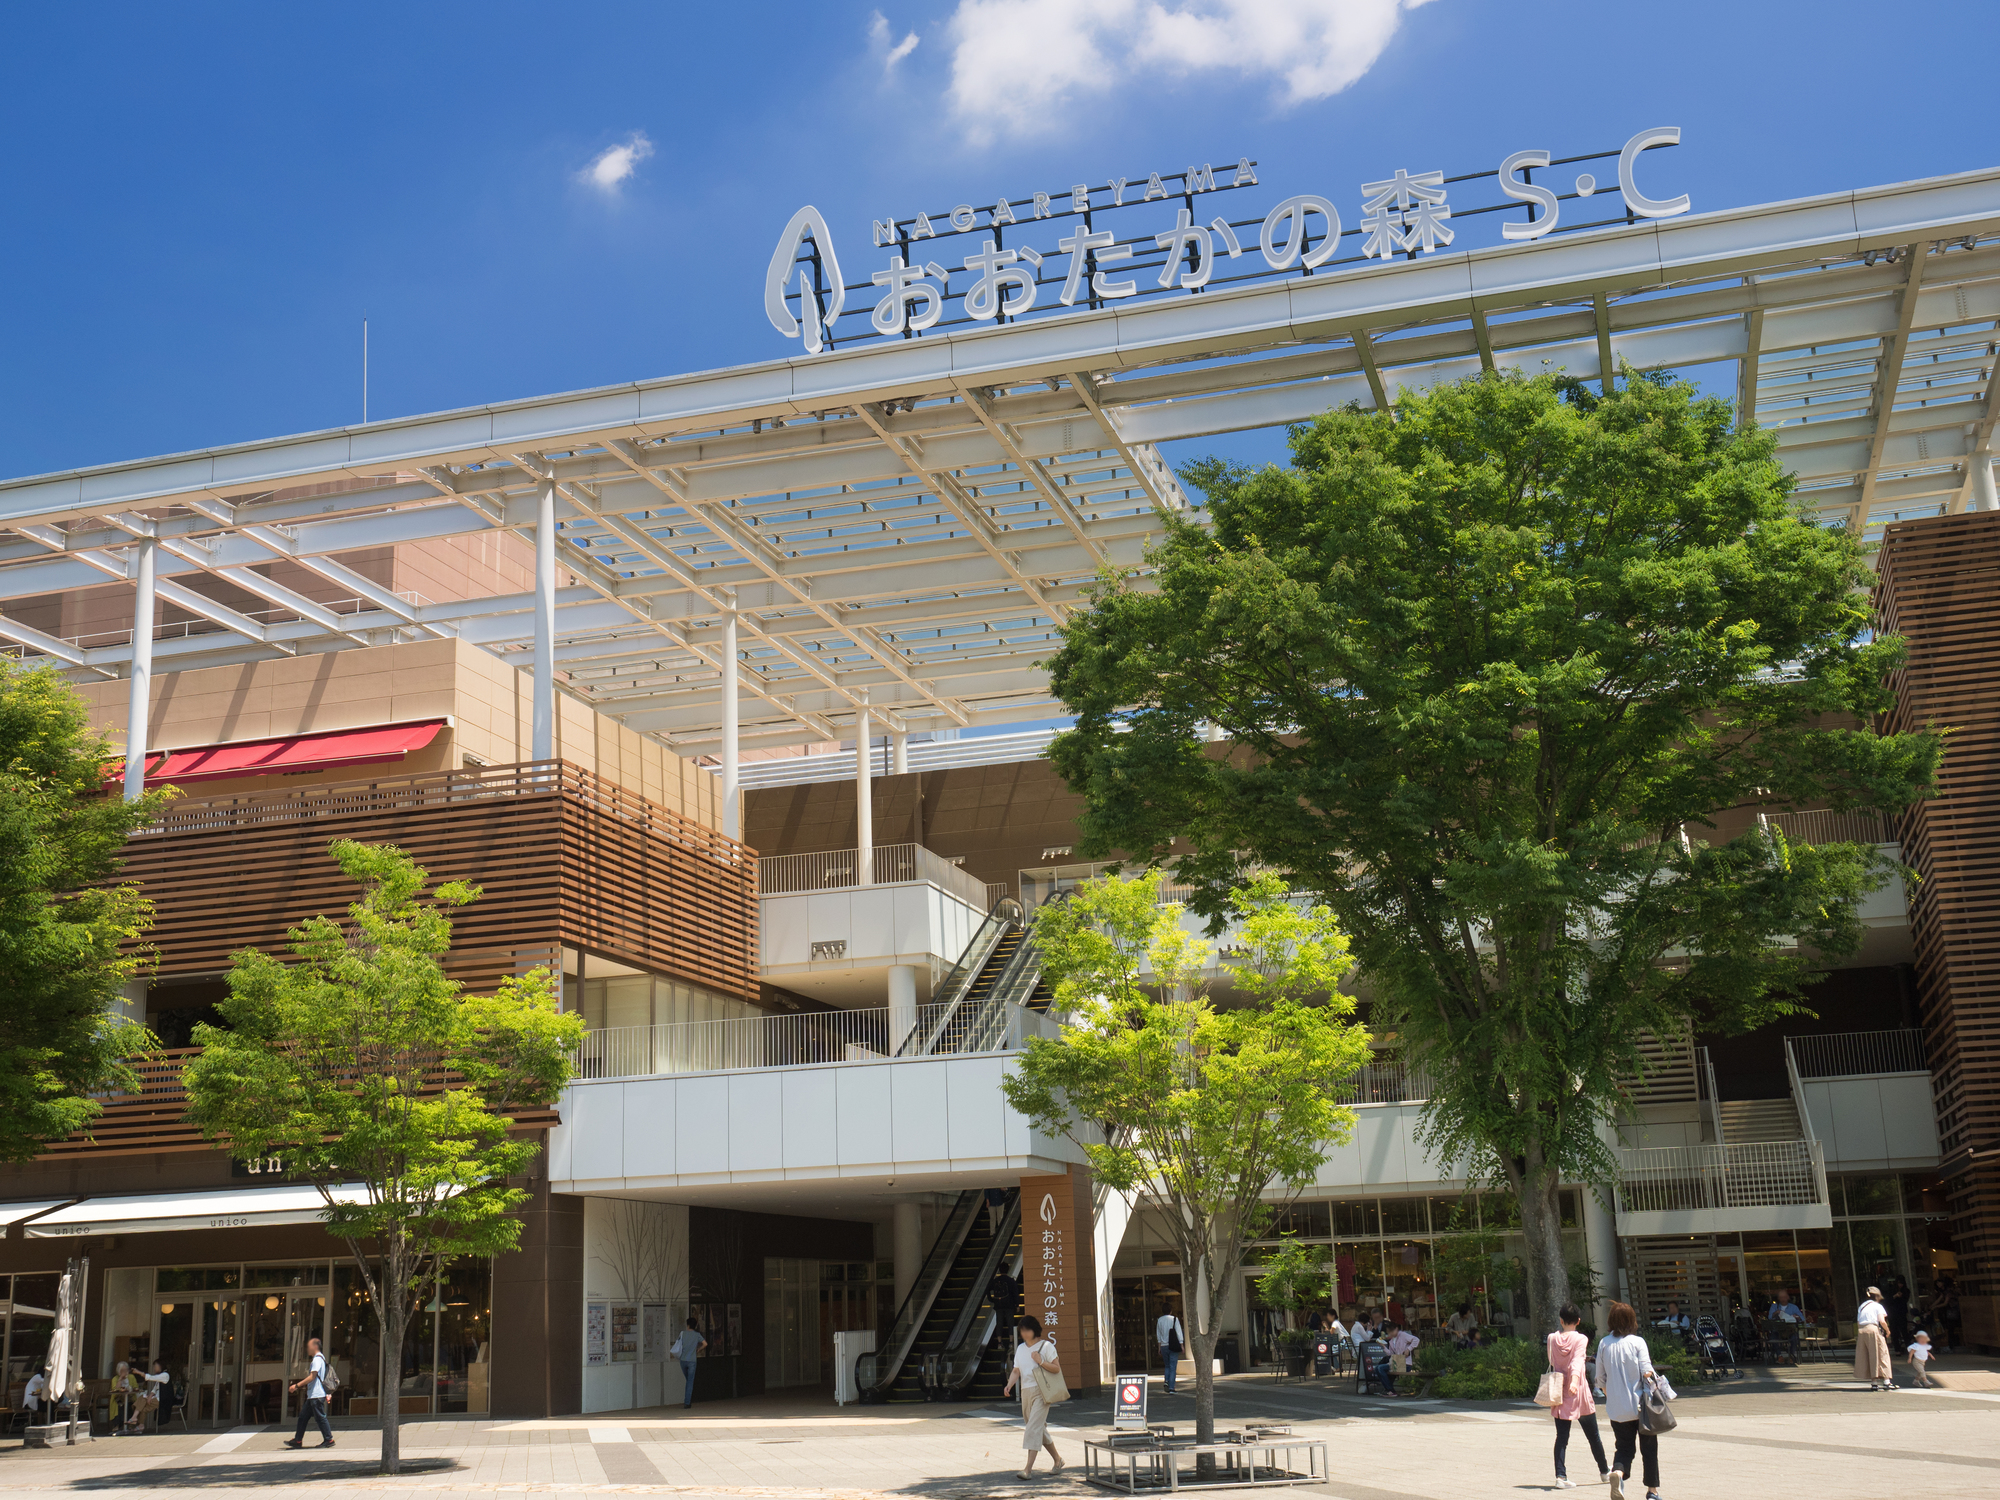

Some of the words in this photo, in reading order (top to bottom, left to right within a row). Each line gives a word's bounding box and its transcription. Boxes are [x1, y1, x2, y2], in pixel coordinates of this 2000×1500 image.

[872, 157, 1259, 246] NAGAREYAMA
[871, 168, 1454, 336] おおたかの森
[54, 1225, 90, 1236] unico
[210, 1216, 248, 1228] unico
[1042, 1229, 1058, 1326] おおたかの森
[1056, 1230, 1065, 1306] NAGAREYAMA
